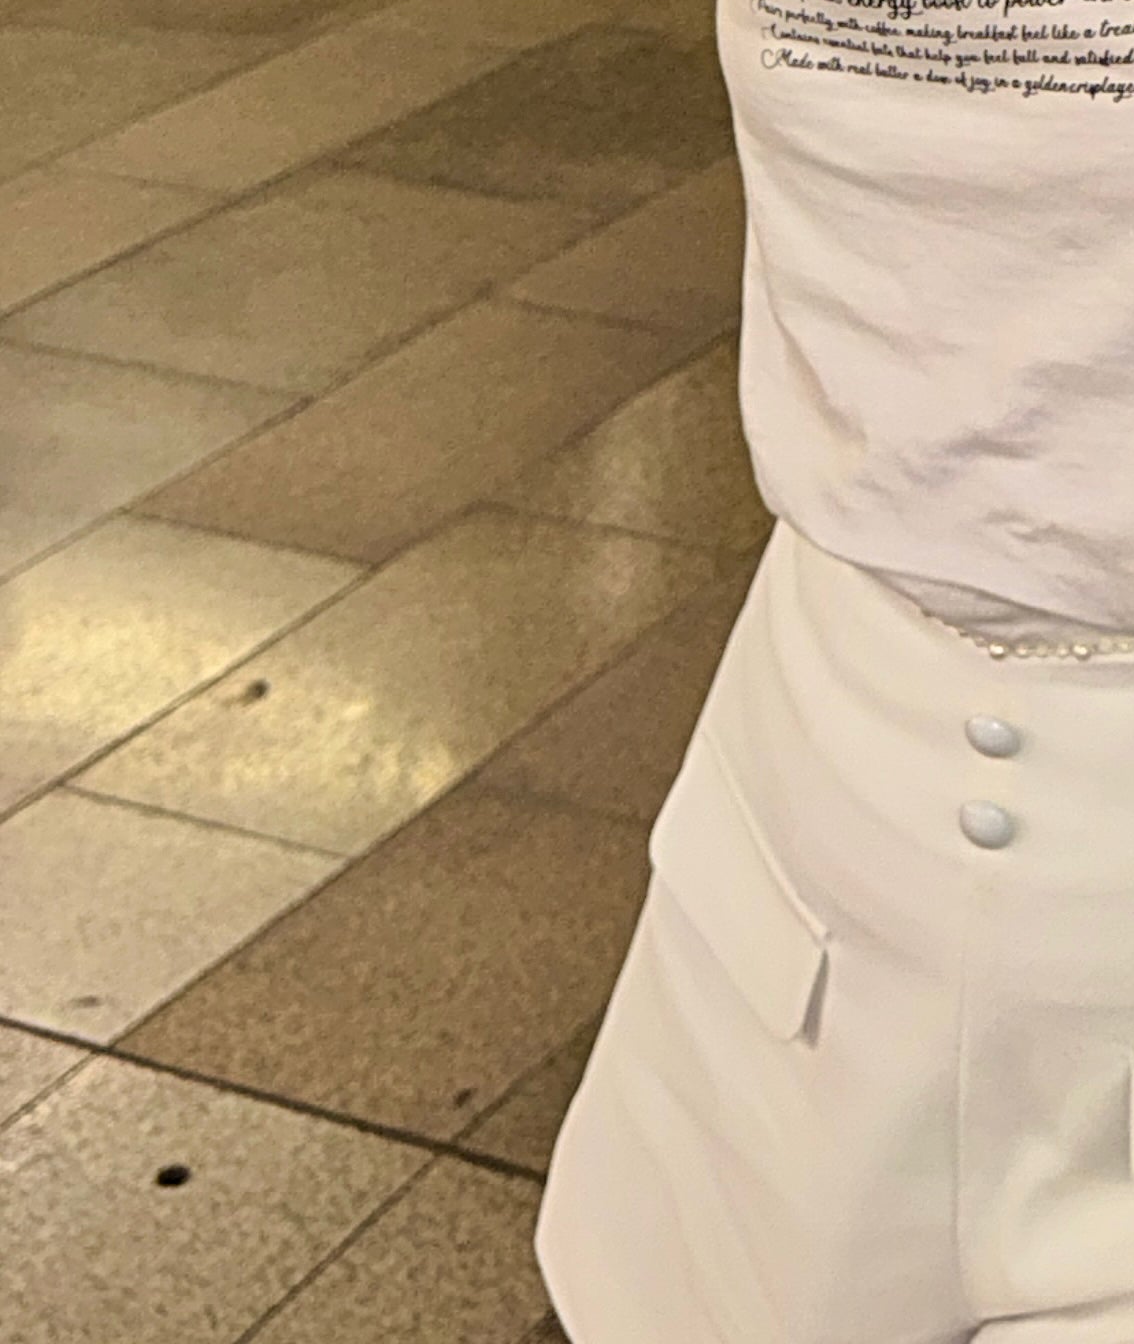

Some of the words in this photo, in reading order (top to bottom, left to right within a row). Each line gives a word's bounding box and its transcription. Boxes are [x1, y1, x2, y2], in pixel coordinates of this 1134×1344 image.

[906, 23, 957, 46] making
[956, 24, 1018, 42] breakfast
[1021, 23, 1050, 42] feel
[1051, 23, 1080, 41] like
[1083, 28, 1096, 40] a
[896, 45, 923, 60] that
[925, 48, 952, 66] help
[955, 54, 981, 68] you
[983, 49, 1009, 65] feel
[1012, 48, 1039, 65] full
[1042, 50, 1071, 64] and
[761, 48, 814, 70] Made
[817, 56, 844, 72] with
[847, 61, 872, 75] real
[875, 62, 909, 80] butter
[966, 74, 996, 93] joy
[994, 76, 1009, 87] in
[1011, 78, 1022, 88] a
